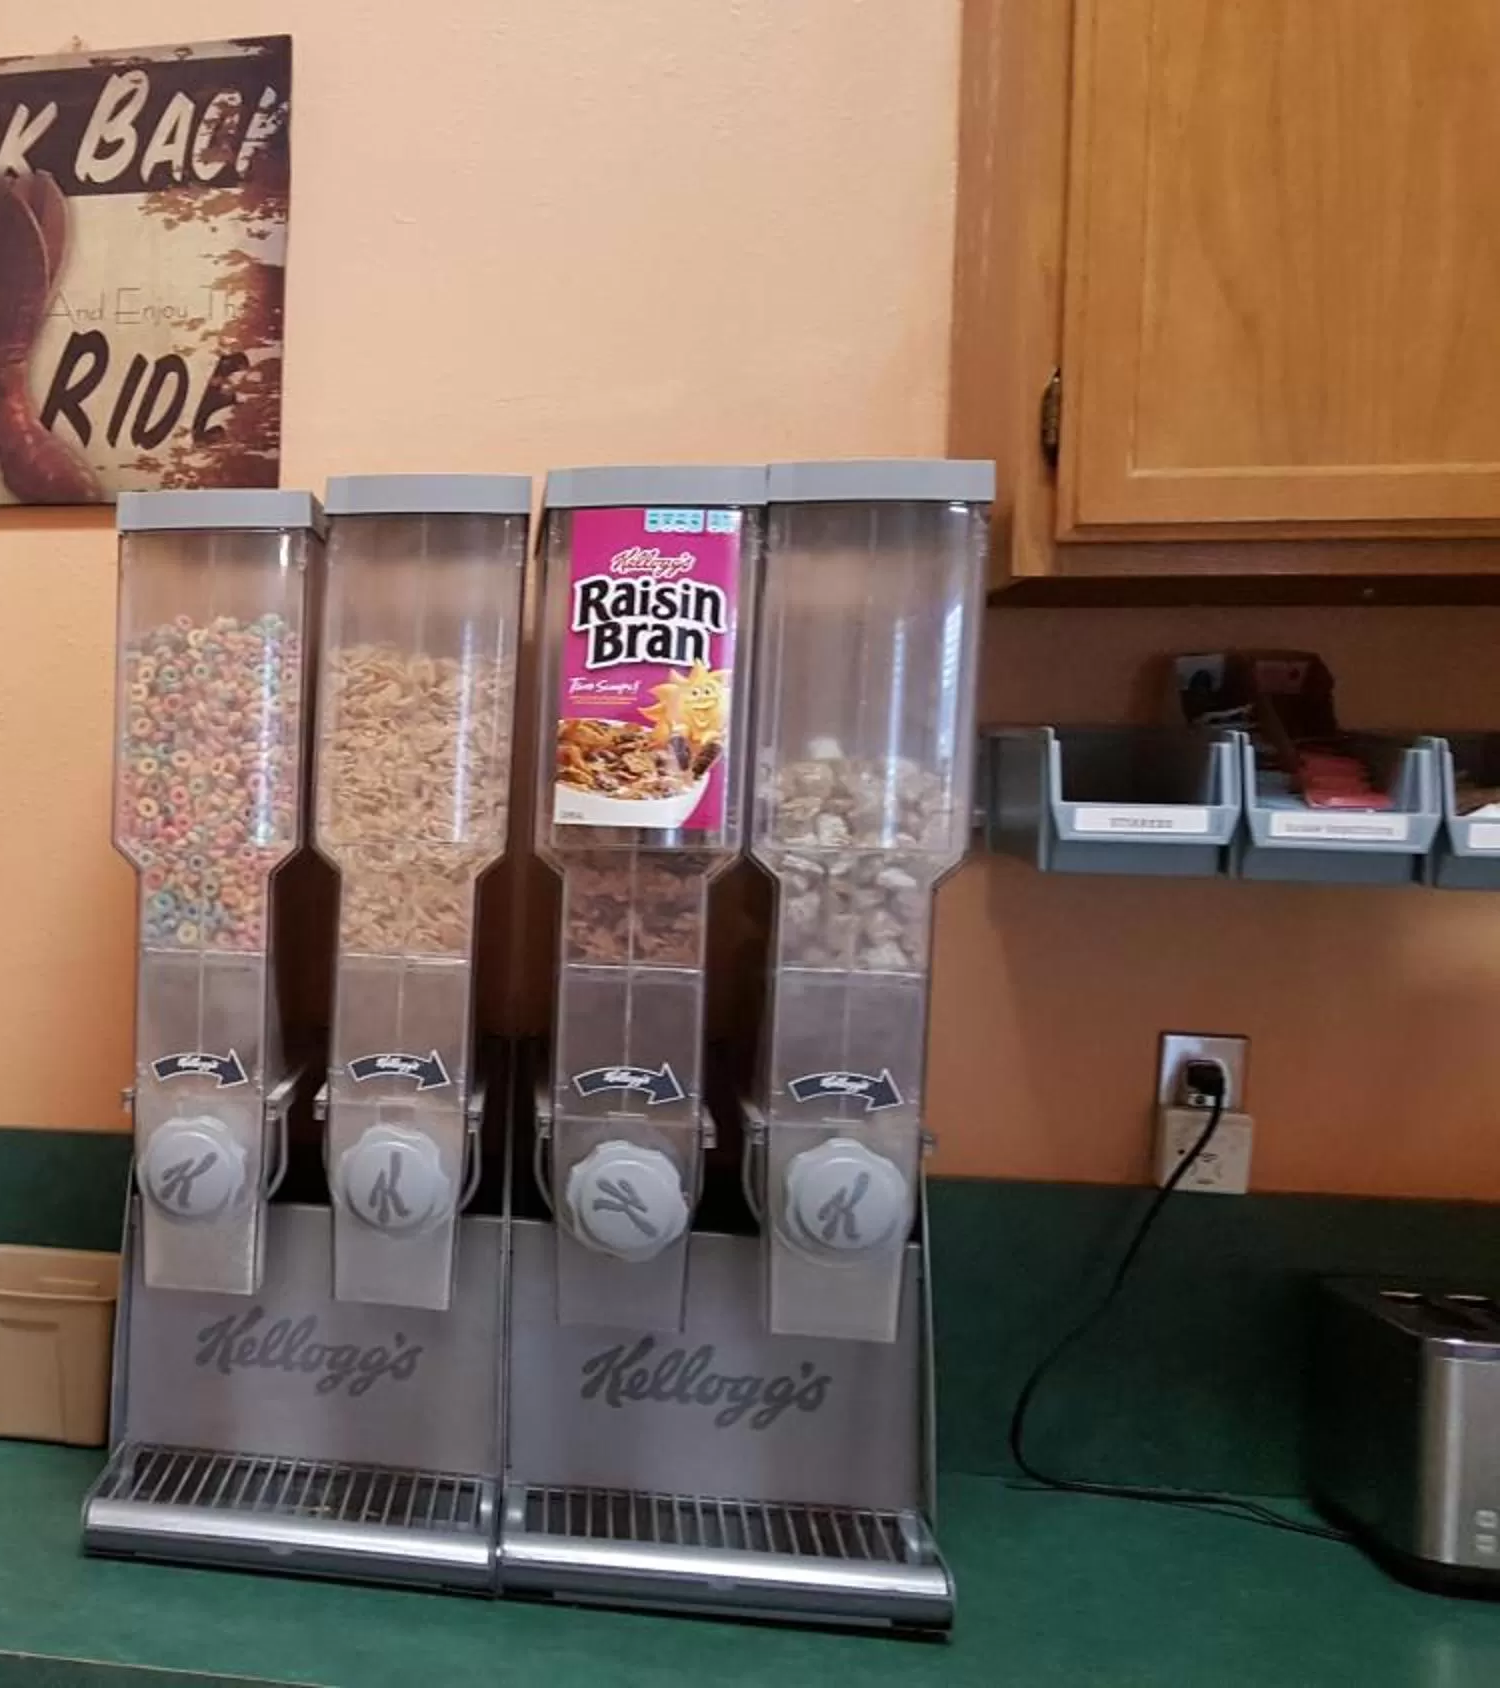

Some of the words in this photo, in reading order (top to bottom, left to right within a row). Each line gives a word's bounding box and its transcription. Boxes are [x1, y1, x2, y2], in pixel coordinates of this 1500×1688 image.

[40, 328, 249, 450] RIDE
[612, 547, 695, 578] Kellogg's
[578, 579, 722, 629] Raisin
[592, 619, 706, 666] Bran
[162, 1153, 217, 1208] K
[368, 1151, 404, 1222] K
[817, 1172, 869, 1241] K
[196, 1306, 423, 1397] Kellogg's
[579, 1332, 832, 1430] Kellogg's
